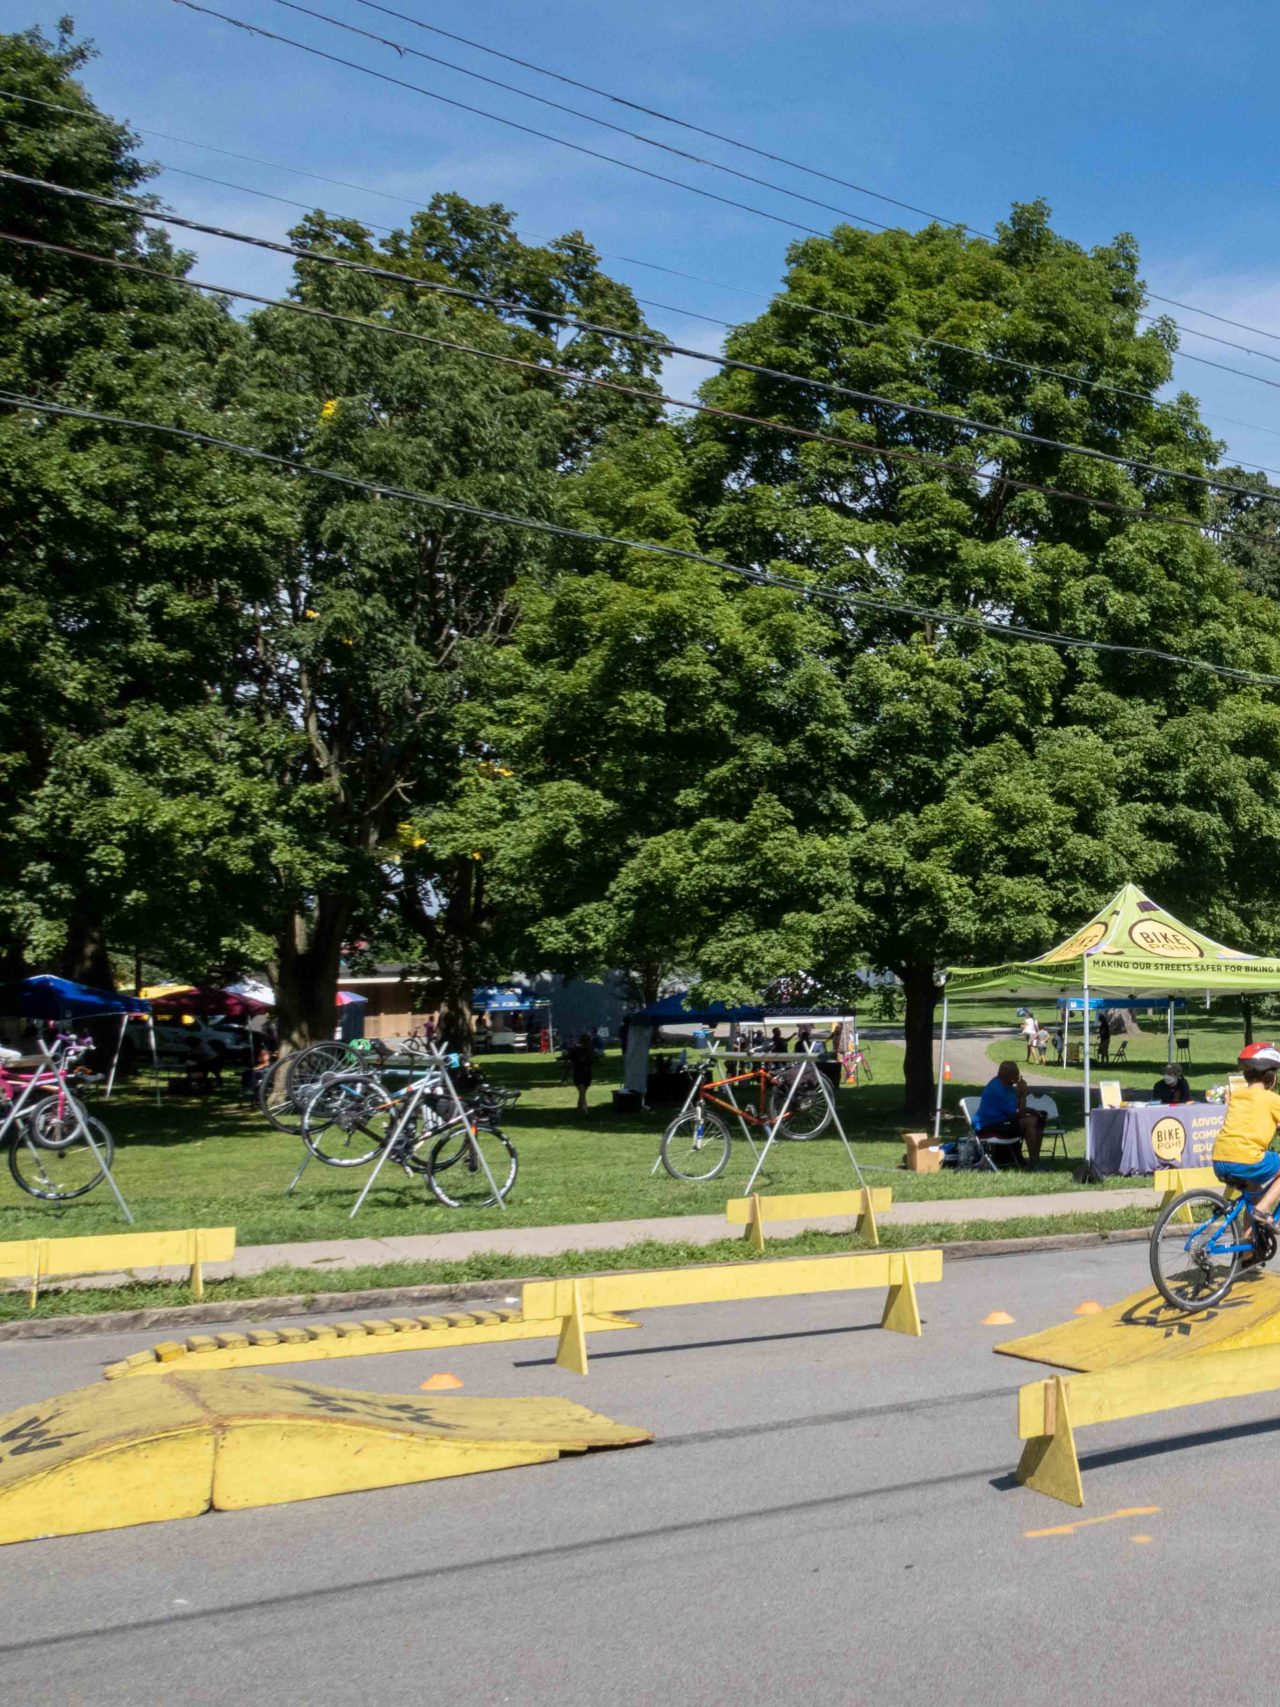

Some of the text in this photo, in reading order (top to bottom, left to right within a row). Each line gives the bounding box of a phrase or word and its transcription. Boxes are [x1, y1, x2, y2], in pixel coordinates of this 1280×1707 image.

[1139, 931, 1187, 946] BIKE
[1037, 963, 1077, 974] EDUCATION
[1092, 960, 1130, 969] MAKING
[1132, 961, 1152, 970] OUR
[1154, 963, 1193, 972] STREETS
[1194, 964, 1223, 972] SAFER
[1224, 964, 1242, 973] FOR
[1244, 965, 1274, 973] BIKING
[1191, 1115, 1224, 1128] ADVOC
[1156, 1127, 1181, 1143] BIKE
[1157, 1140, 1182, 1150] PGH!
